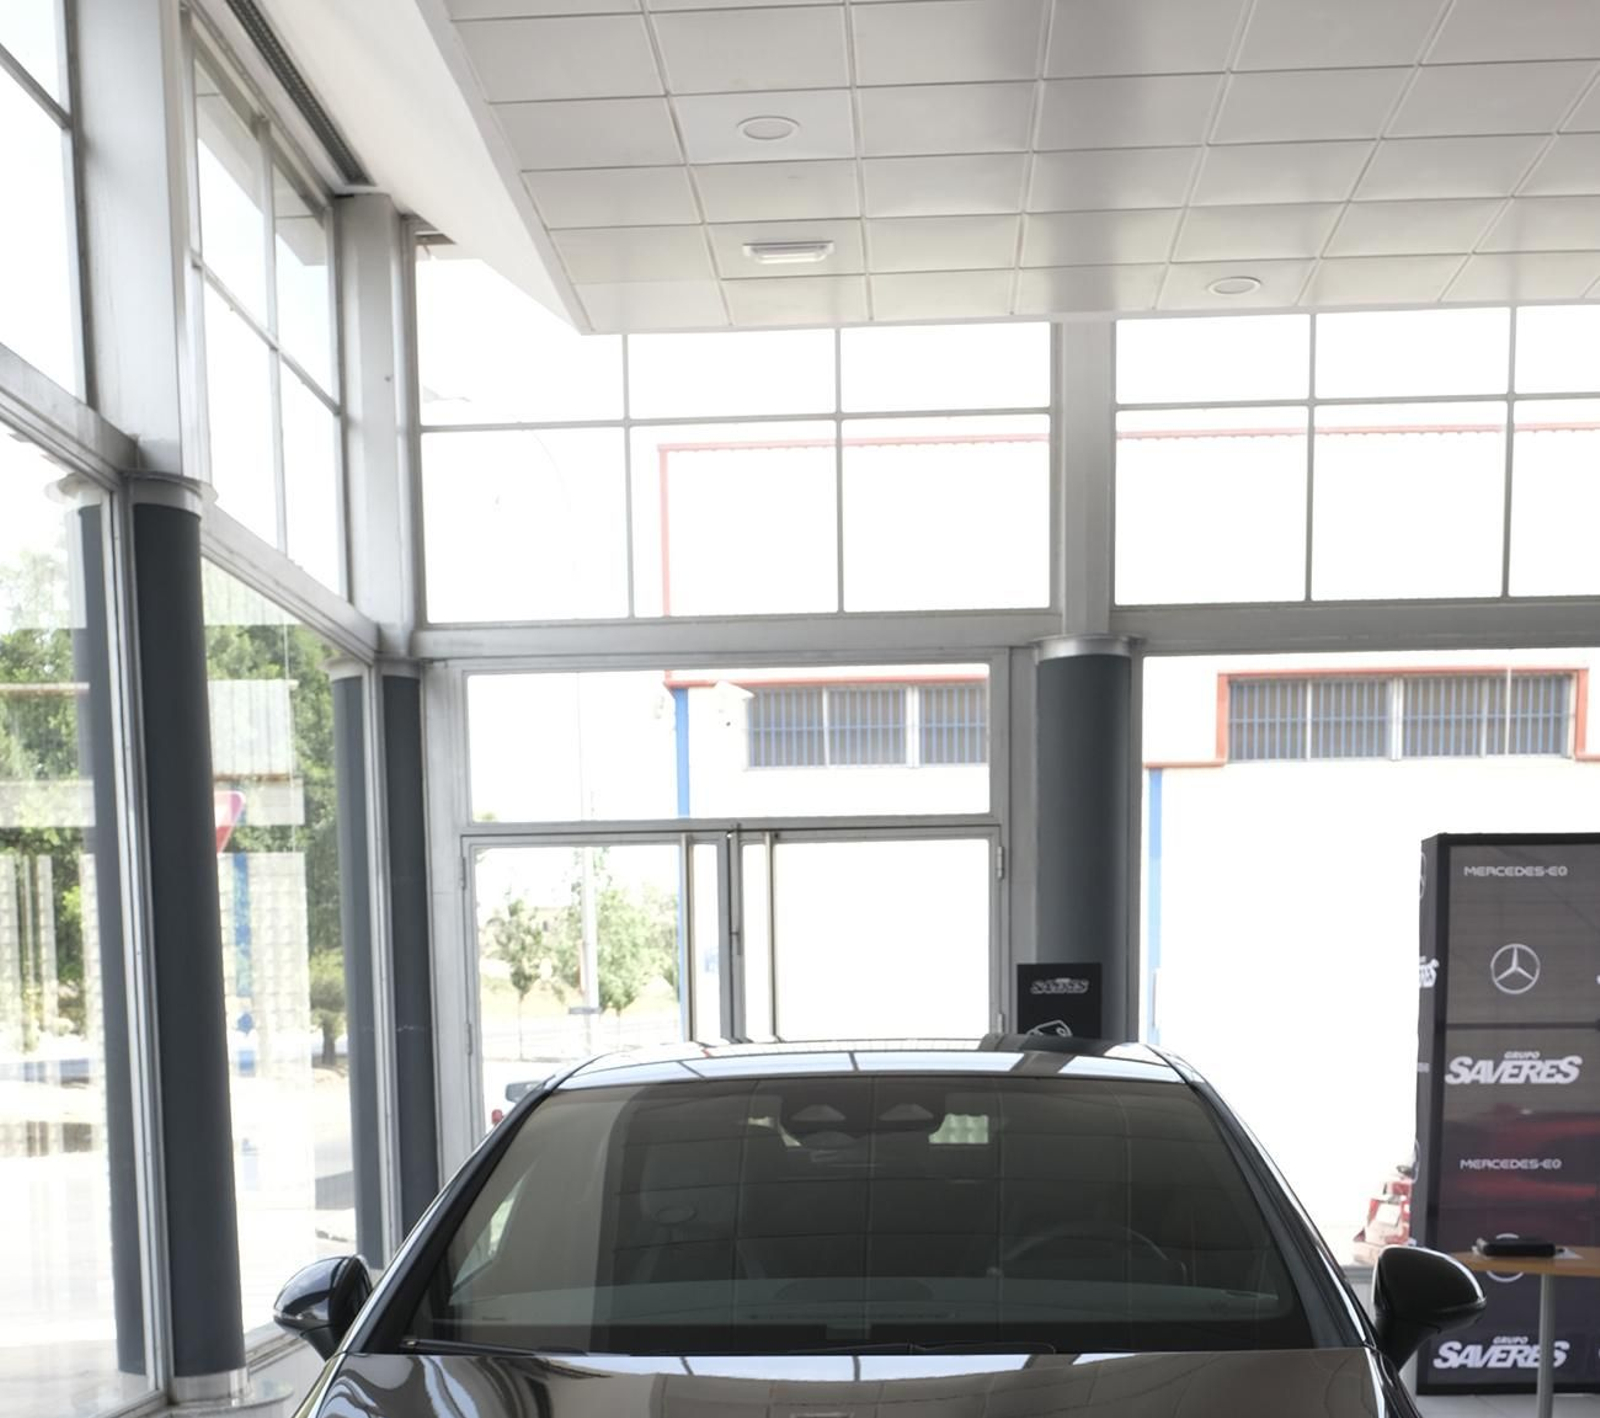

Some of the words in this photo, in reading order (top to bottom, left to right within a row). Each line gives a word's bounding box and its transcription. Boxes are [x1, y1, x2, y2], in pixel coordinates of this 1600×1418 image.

[1504, 1051, 1541, 1060] GRUPO
[1445, 1055, 1583, 1085] SAVERES
[1493, 1336, 1529, 1344] GRUPO
